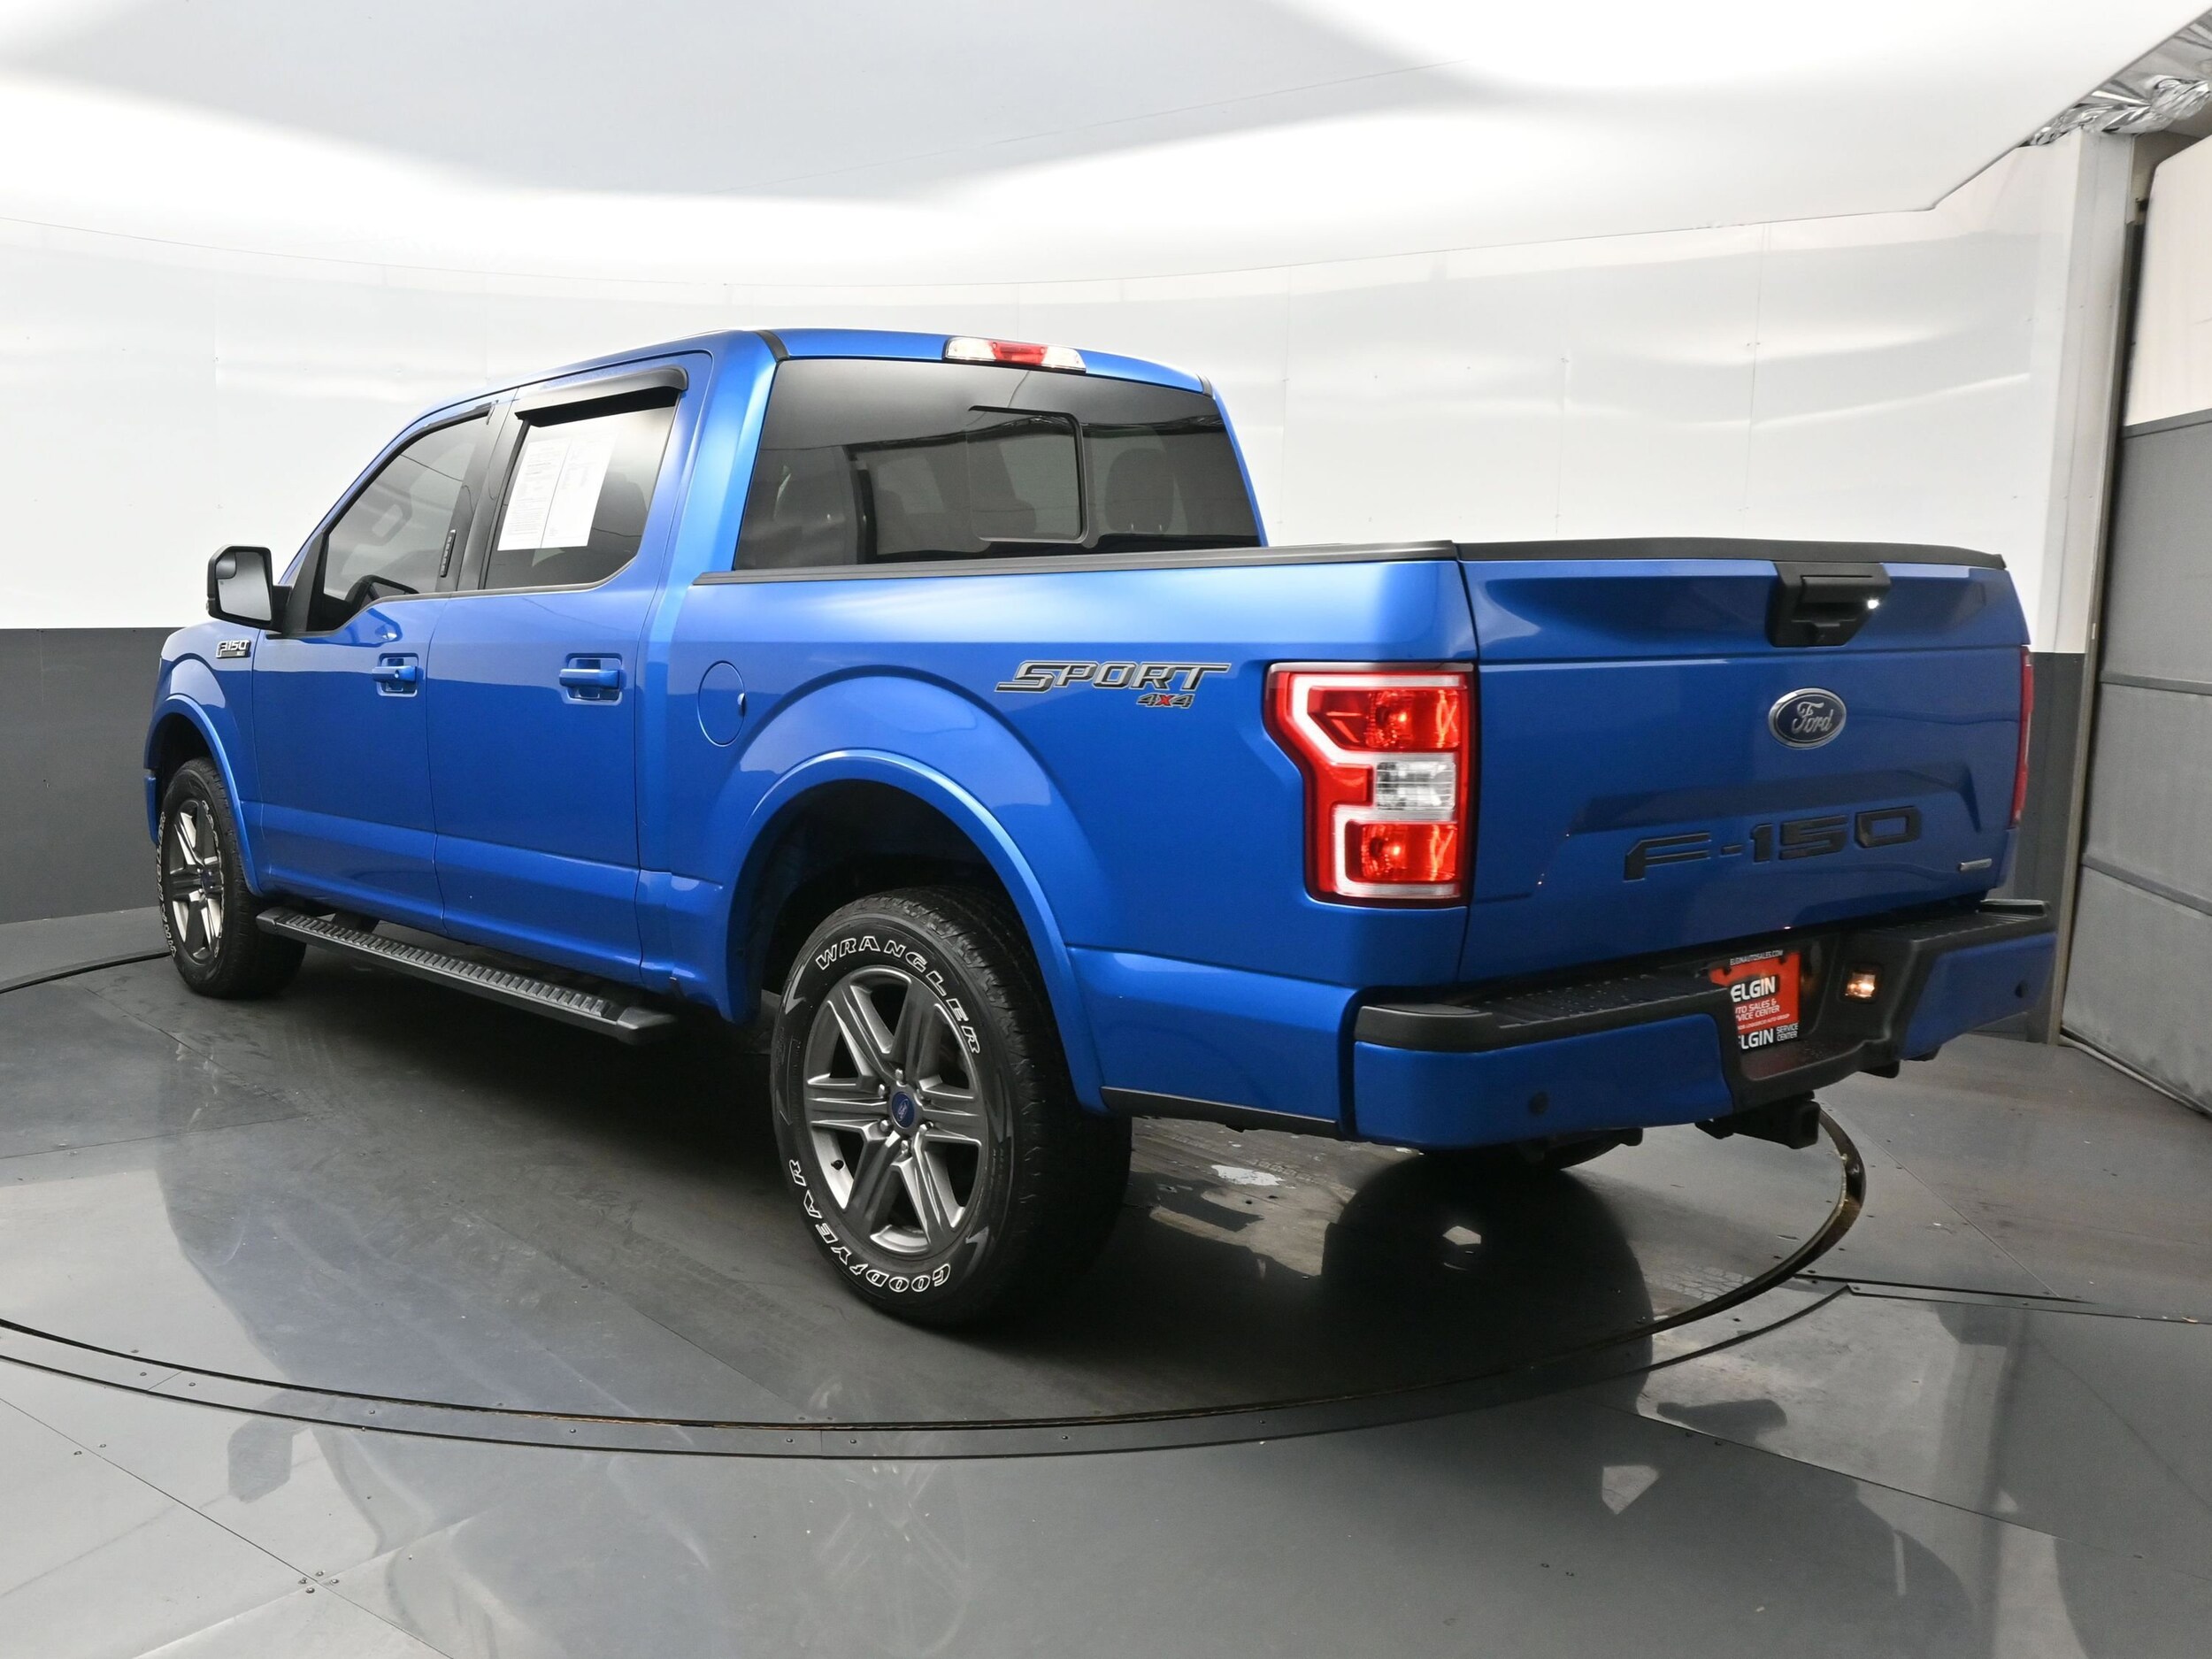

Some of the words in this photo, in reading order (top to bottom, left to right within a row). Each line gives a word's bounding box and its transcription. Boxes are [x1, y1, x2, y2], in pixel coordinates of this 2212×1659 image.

[995, 660, 1232, 693] SPORT
[1791, 701, 1834, 734] Ford
[1624, 806, 1922, 882] F-150
[815, 935, 980, 1055] WRANGLER
[1730, 976, 1776, 1002] ELGIN
[1736, 1011, 1754, 1022] VICE
[1755, 1005, 1780, 1018] CENTER
[1748, 1000, 1770, 1012] SALES
[788, 1159, 952, 1293] GOODYEAR
